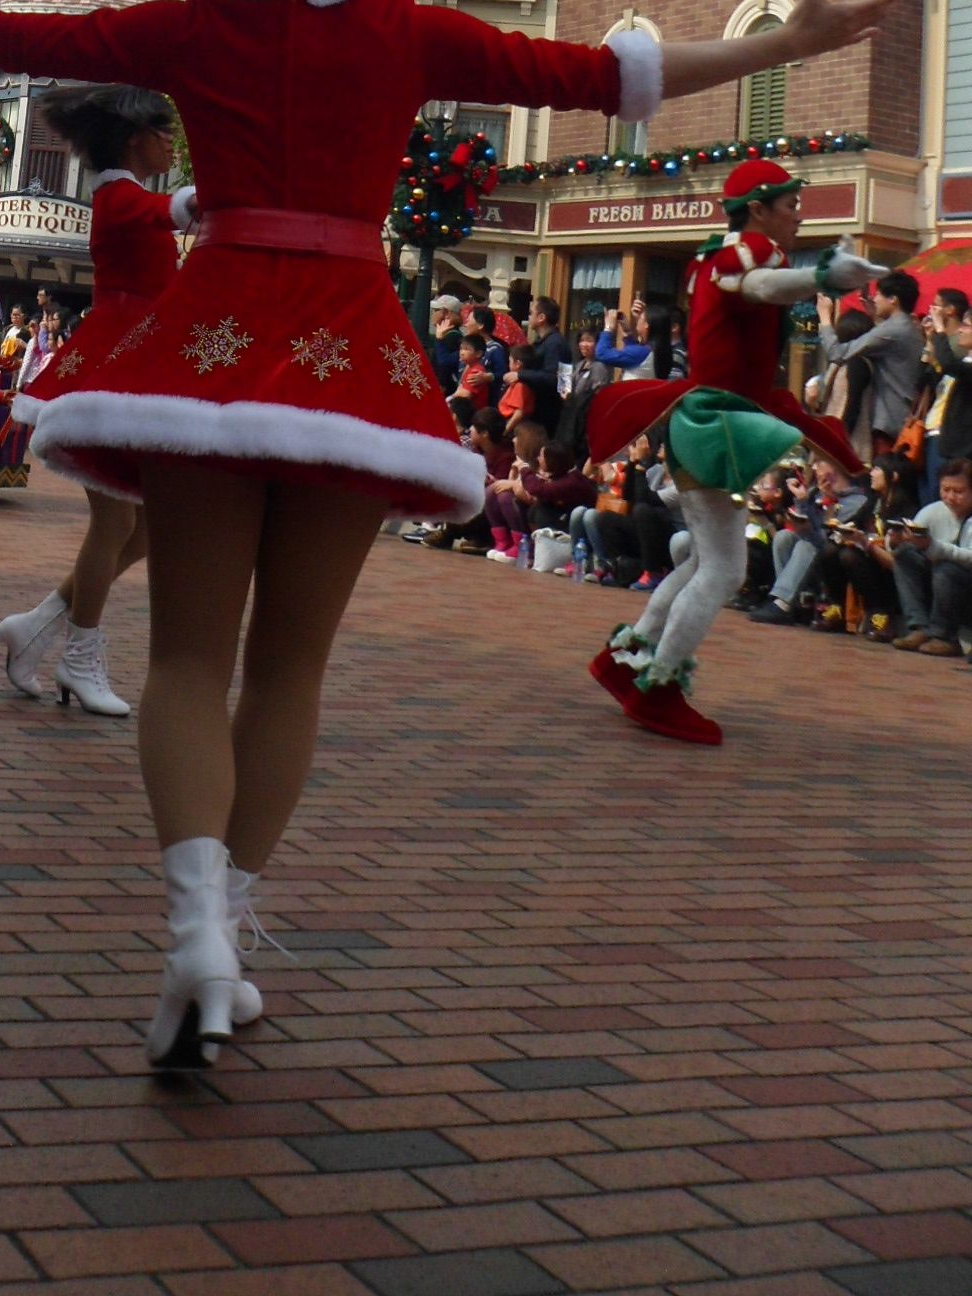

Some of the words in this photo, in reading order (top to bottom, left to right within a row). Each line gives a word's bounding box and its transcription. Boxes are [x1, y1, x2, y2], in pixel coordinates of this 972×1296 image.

[38, 200, 90, 221] STRE
[588, 205, 645, 223] FRESH
[651, 200, 714, 220] BAKED
